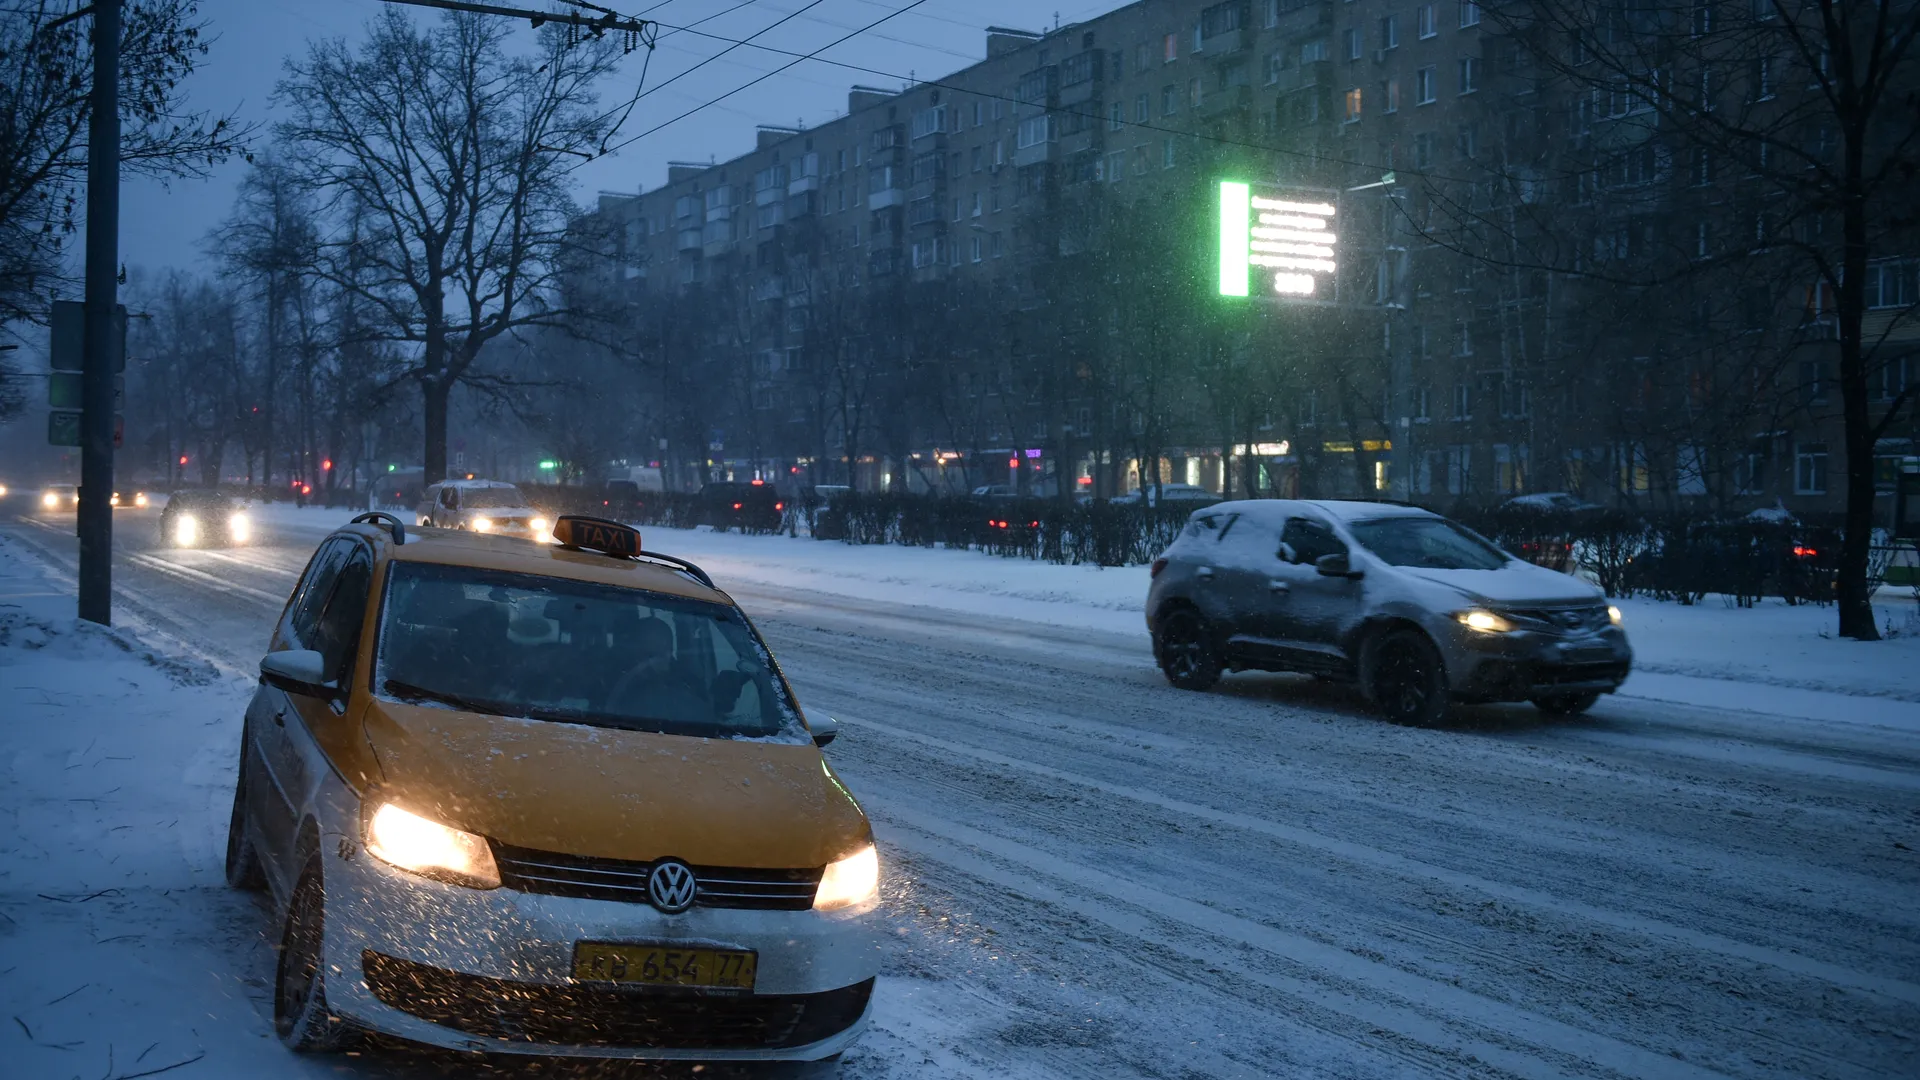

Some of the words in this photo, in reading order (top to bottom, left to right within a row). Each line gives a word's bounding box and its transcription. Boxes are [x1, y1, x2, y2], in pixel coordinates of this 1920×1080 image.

[580, 525, 626, 549] TAXI
[651, 863, 695, 910] VW
[643, 952, 698, 982] 654
[717, 954, 745, 977] 77
[719, 977, 739, 986] RUS
